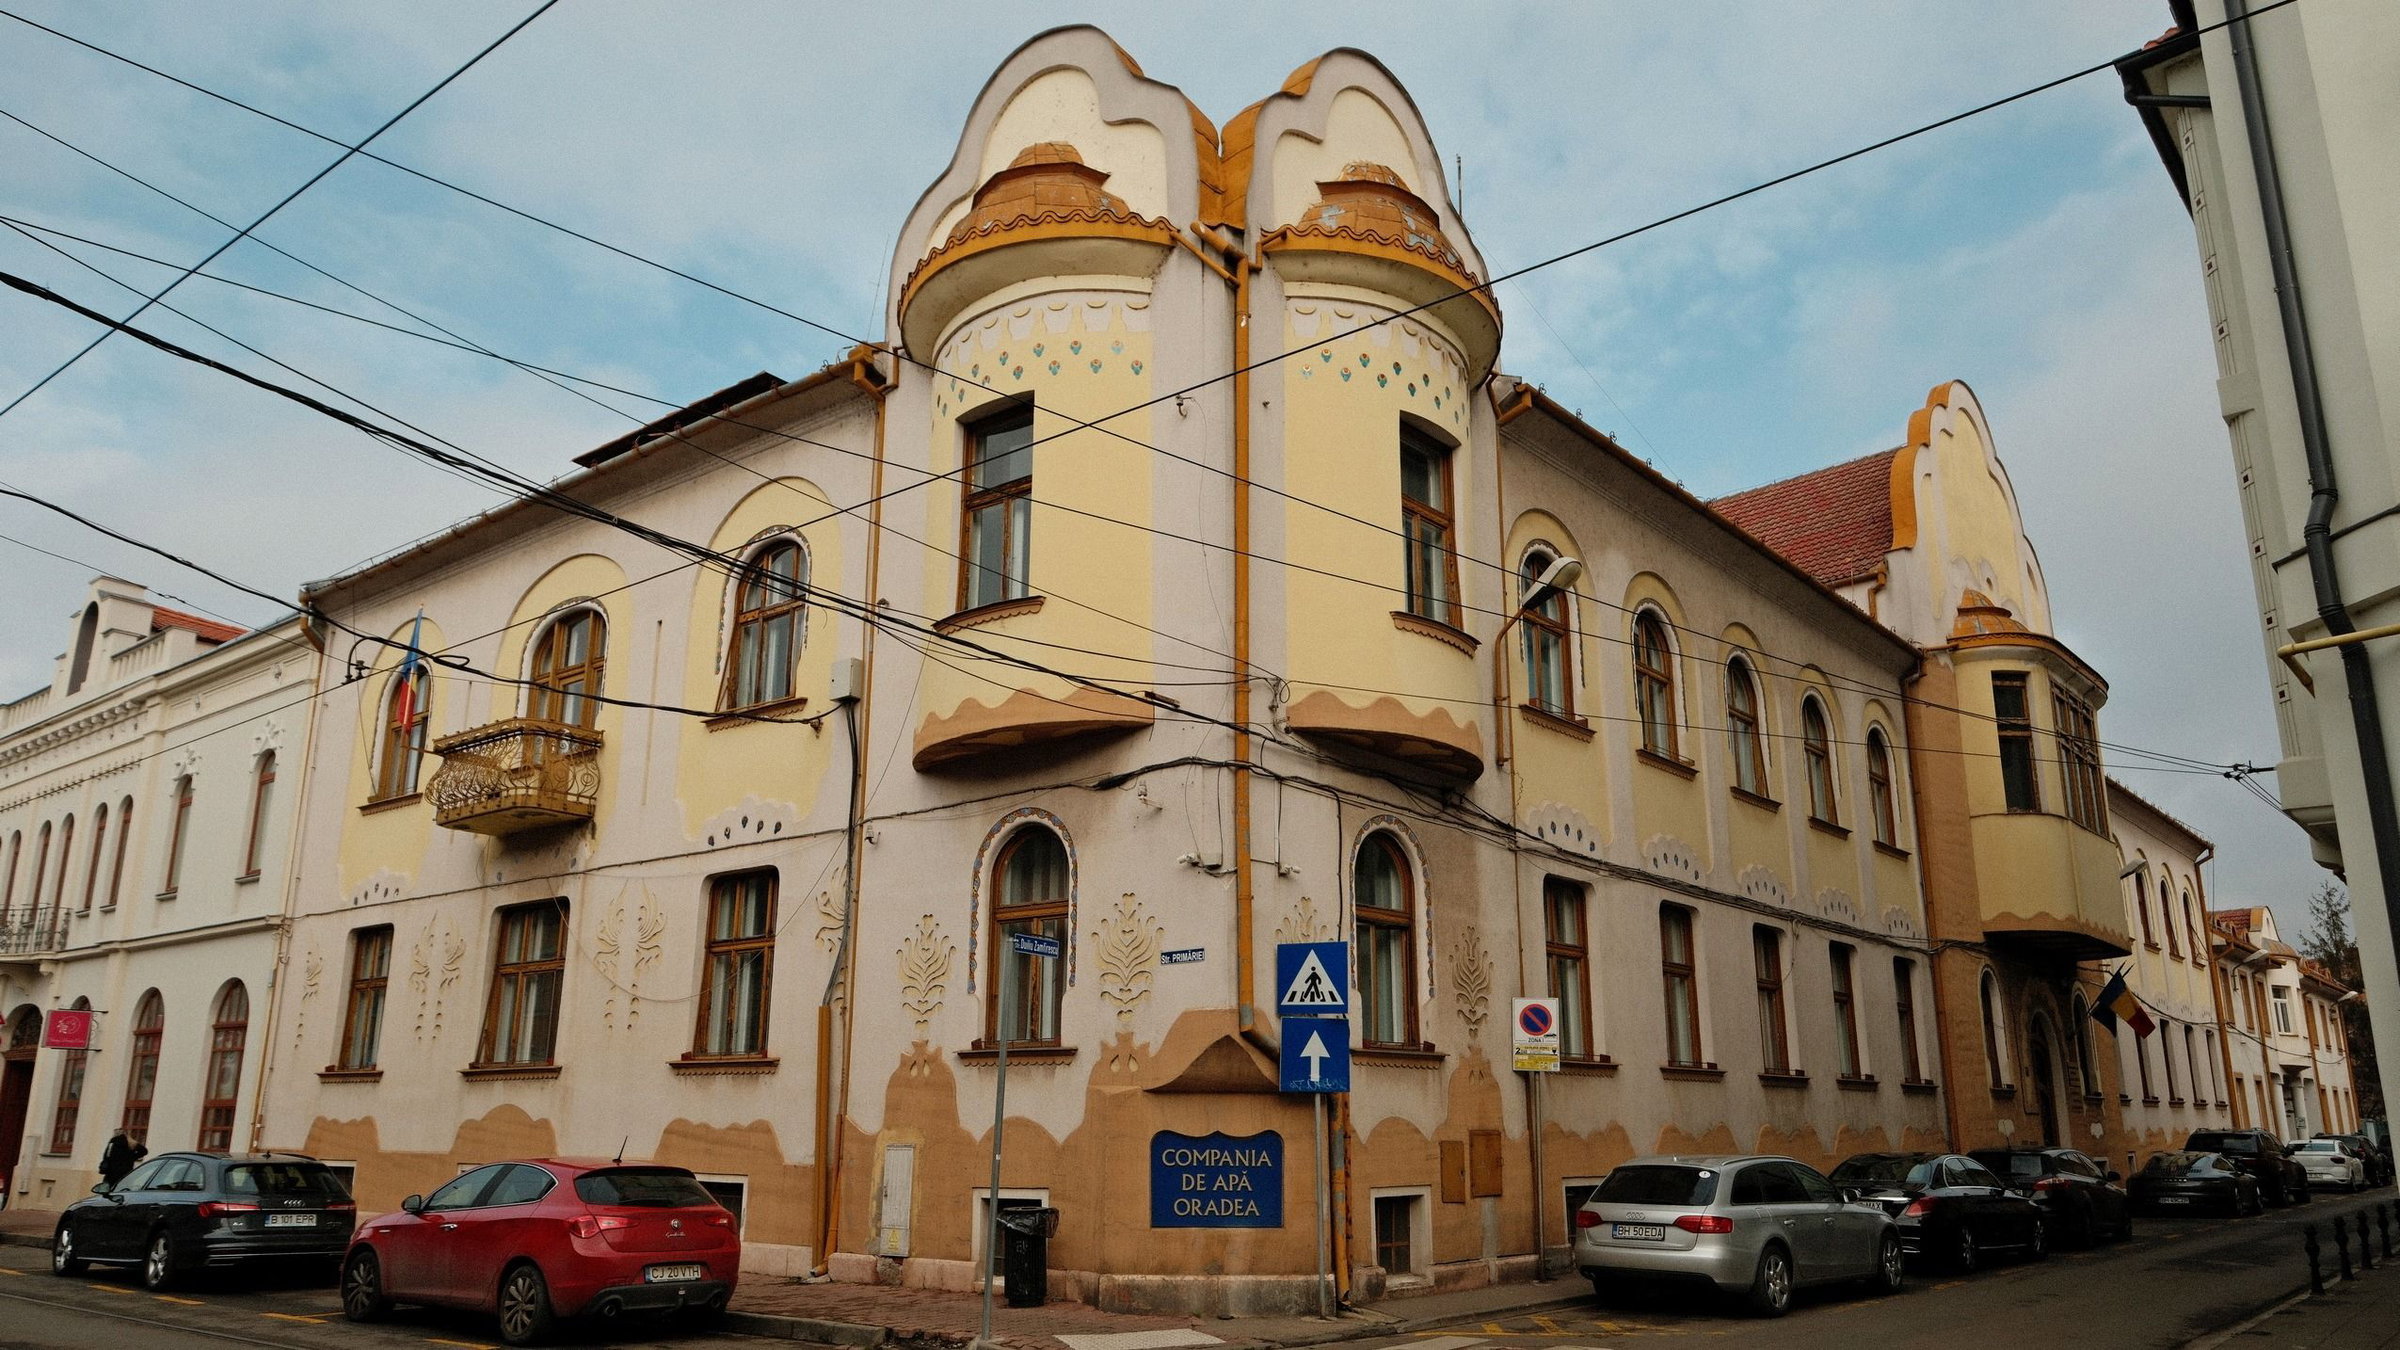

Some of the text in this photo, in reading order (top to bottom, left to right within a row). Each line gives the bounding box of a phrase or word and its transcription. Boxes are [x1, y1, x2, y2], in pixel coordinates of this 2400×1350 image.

[1162, 1149, 1272, 1167] COMPANIA
[1182, 1170, 1252, 1191] DE APĂ
[1174, 1198, 1260, 1216] ORADEA
[295, 1215, 315, 1224] EPR
[1618, 1226, 1631, 1236] BH
[651, 1265, 700, 1279] CJ 20 VTH
